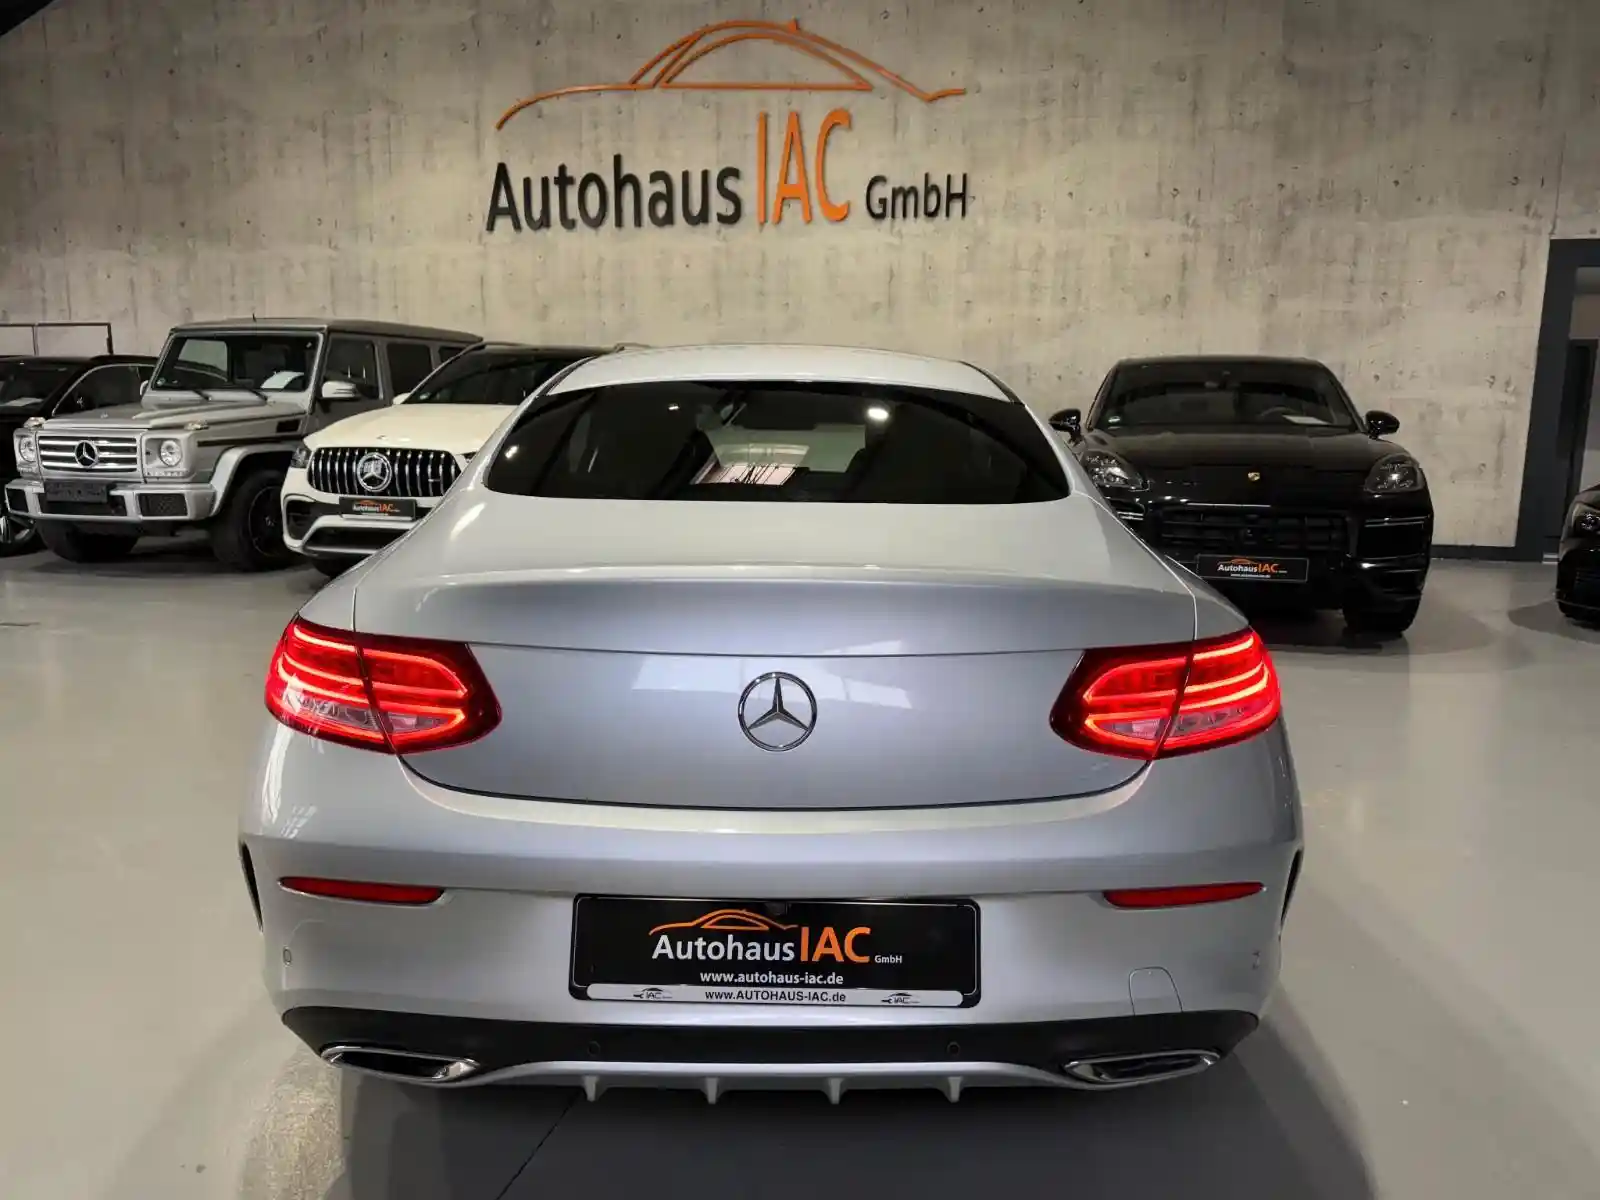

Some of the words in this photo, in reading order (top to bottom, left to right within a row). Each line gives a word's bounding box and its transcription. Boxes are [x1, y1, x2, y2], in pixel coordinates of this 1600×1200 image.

[485, 154, 741, 231] Autohaus
[757, 108, 851, 224] IAC
[866, 172, 967, 219] GmbH
[1217, 563, 1258, 573] Autohaus
[1259, 563, 1278, 573] IAC
[652, 934, 795, 962] Autohaus
[801, 926, 872, 964] IAC
[874, 954, 903, 964] GmbH
[700, 969, 844, 986] www.autohaus-iac.de
[705, 988, 847, 1003] www.AUTOHAUS-IAC.de
